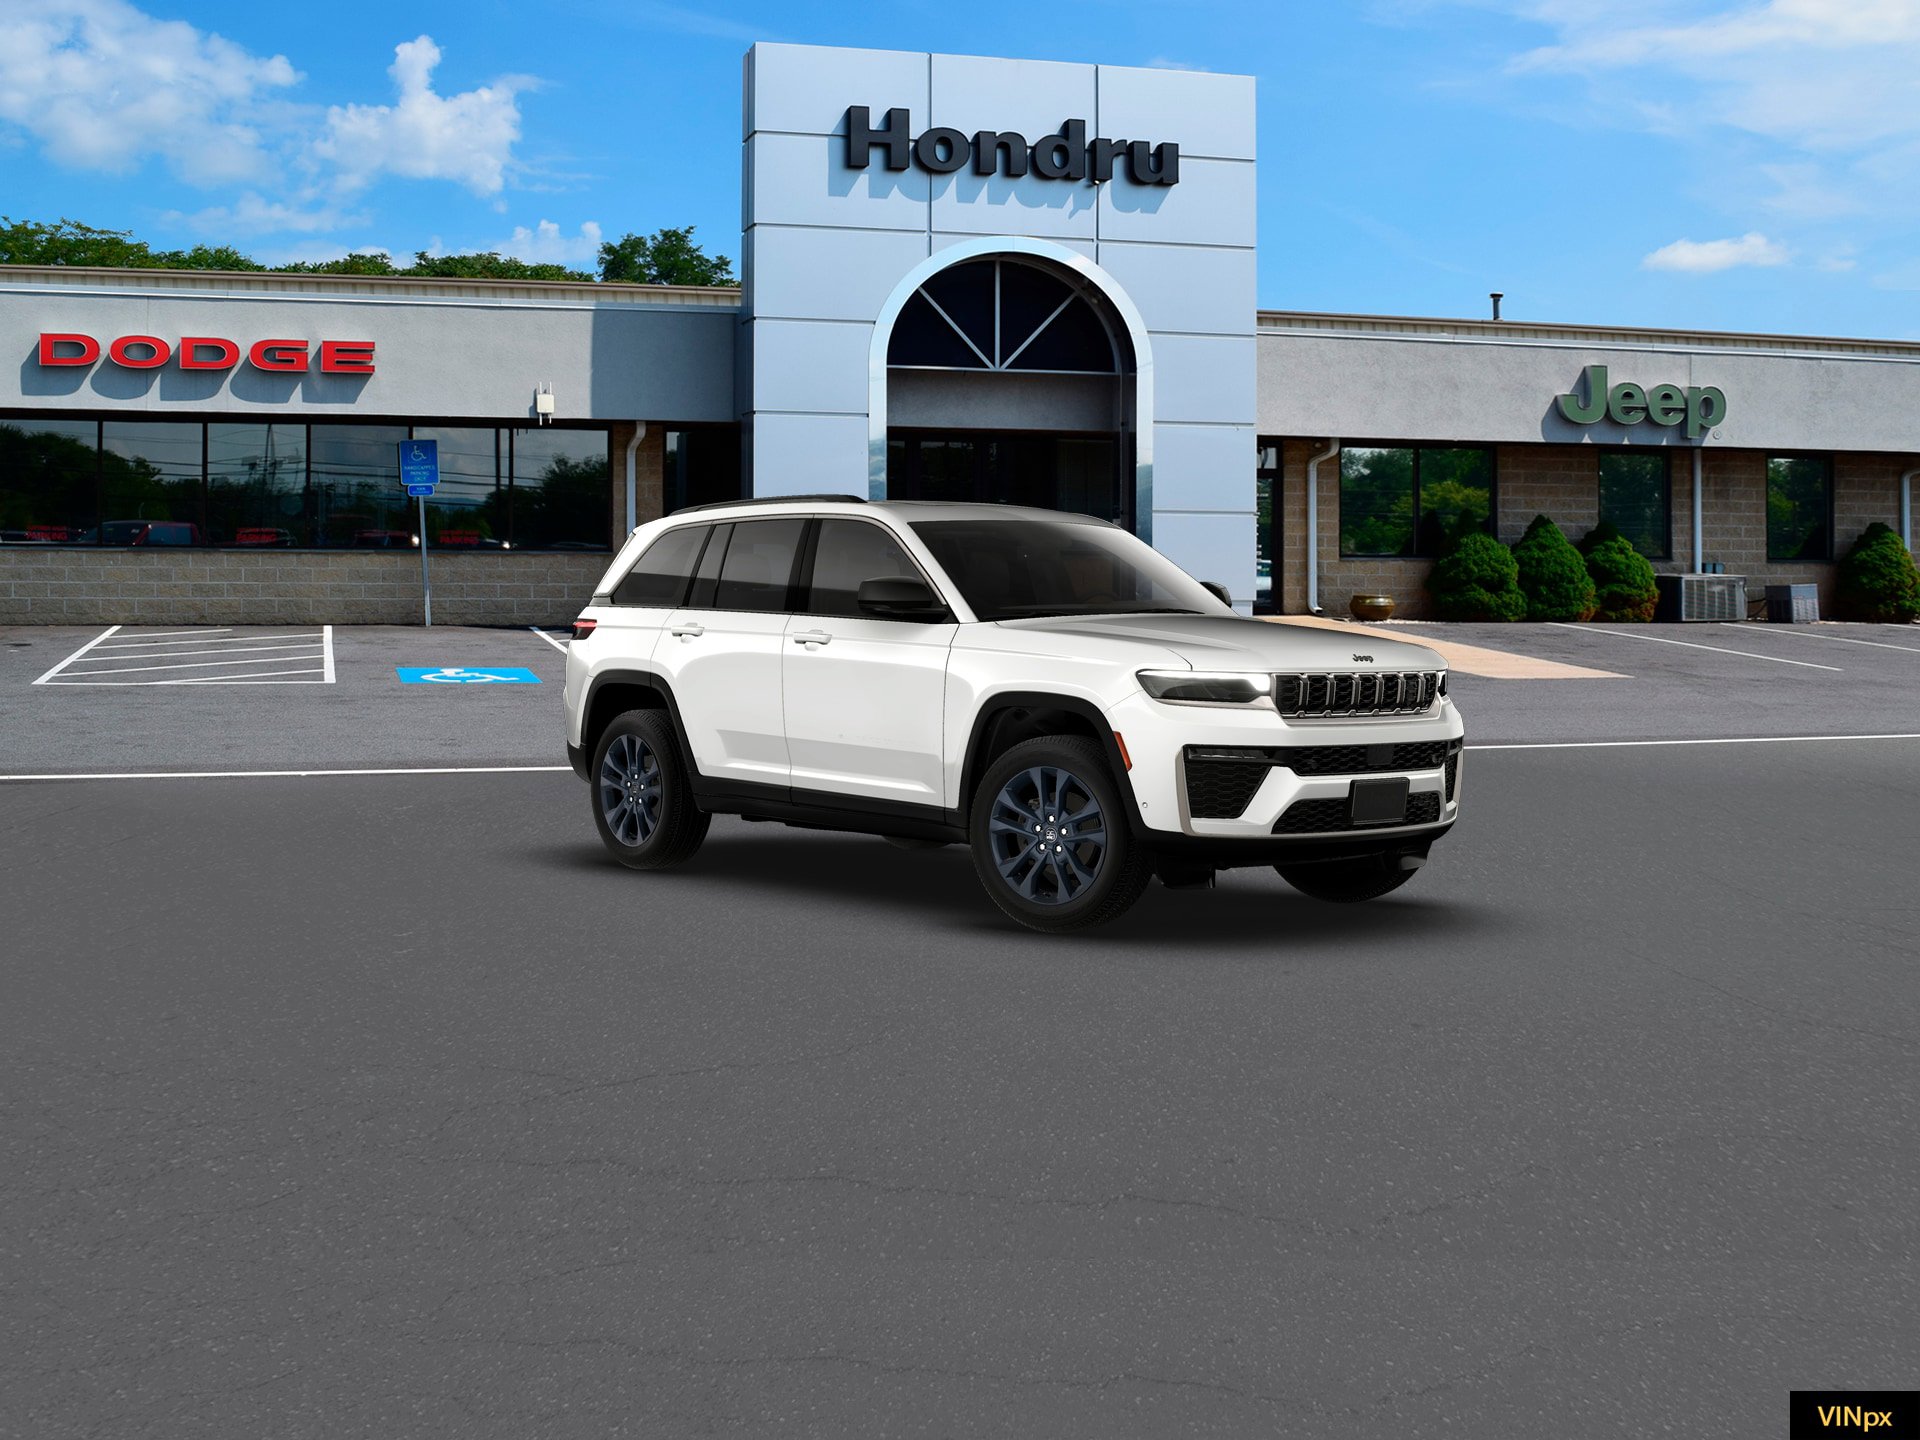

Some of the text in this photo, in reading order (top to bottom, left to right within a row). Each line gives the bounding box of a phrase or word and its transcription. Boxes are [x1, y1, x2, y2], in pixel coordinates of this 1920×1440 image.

[846, 104, 1180, 186] Hondru
[39, 333, 375, 374] DODGE
[1556, 365, 1727, 439] Jeep
[1352, 653, 1374, 663] Jeep
